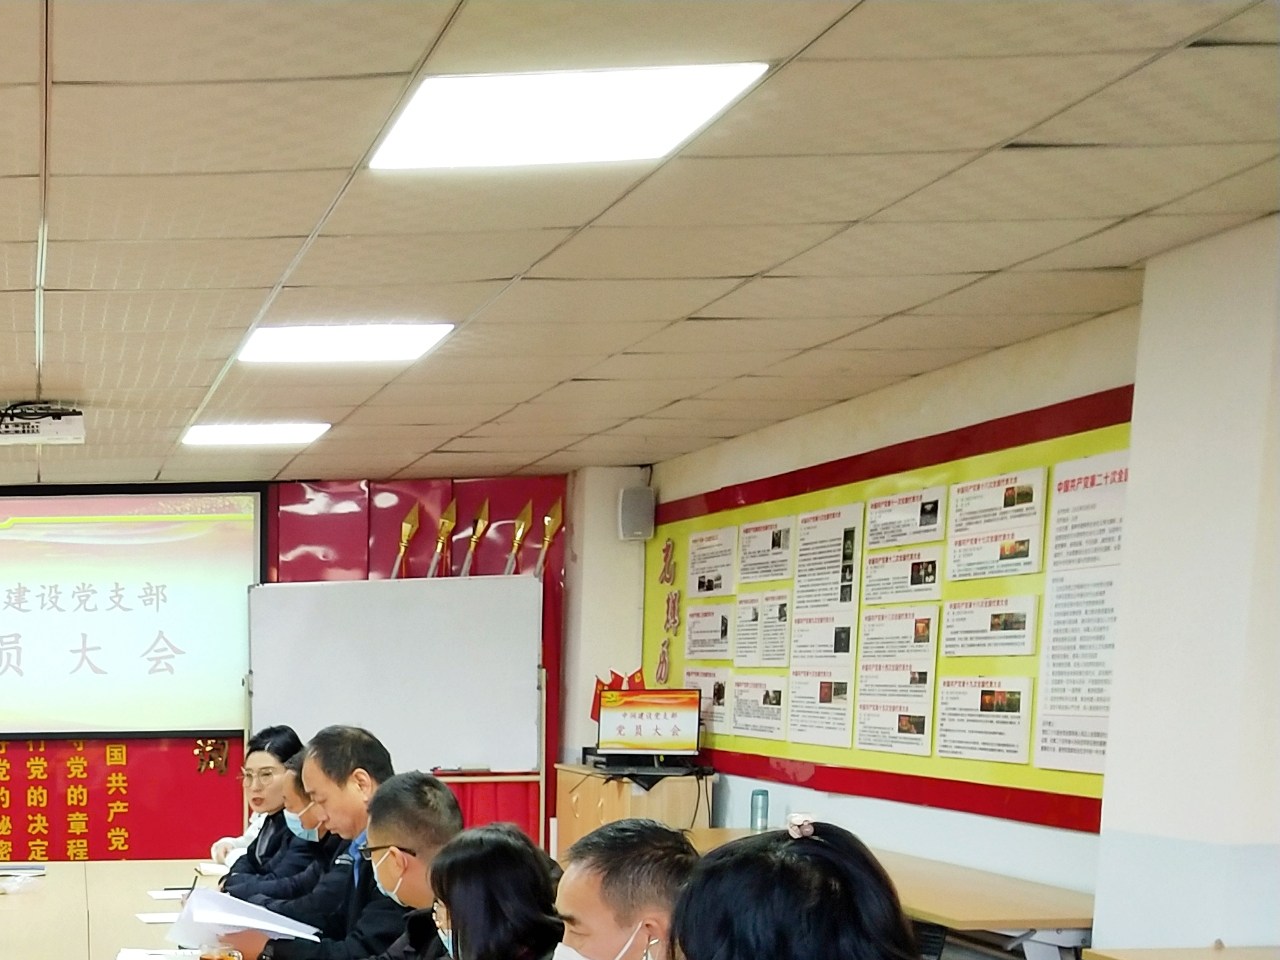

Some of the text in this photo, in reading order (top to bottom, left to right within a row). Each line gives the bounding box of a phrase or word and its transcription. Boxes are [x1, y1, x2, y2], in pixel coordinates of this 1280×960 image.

[616, 724, 680, 736] 党员大会
[106, 744, 129, 850] 国共产党
